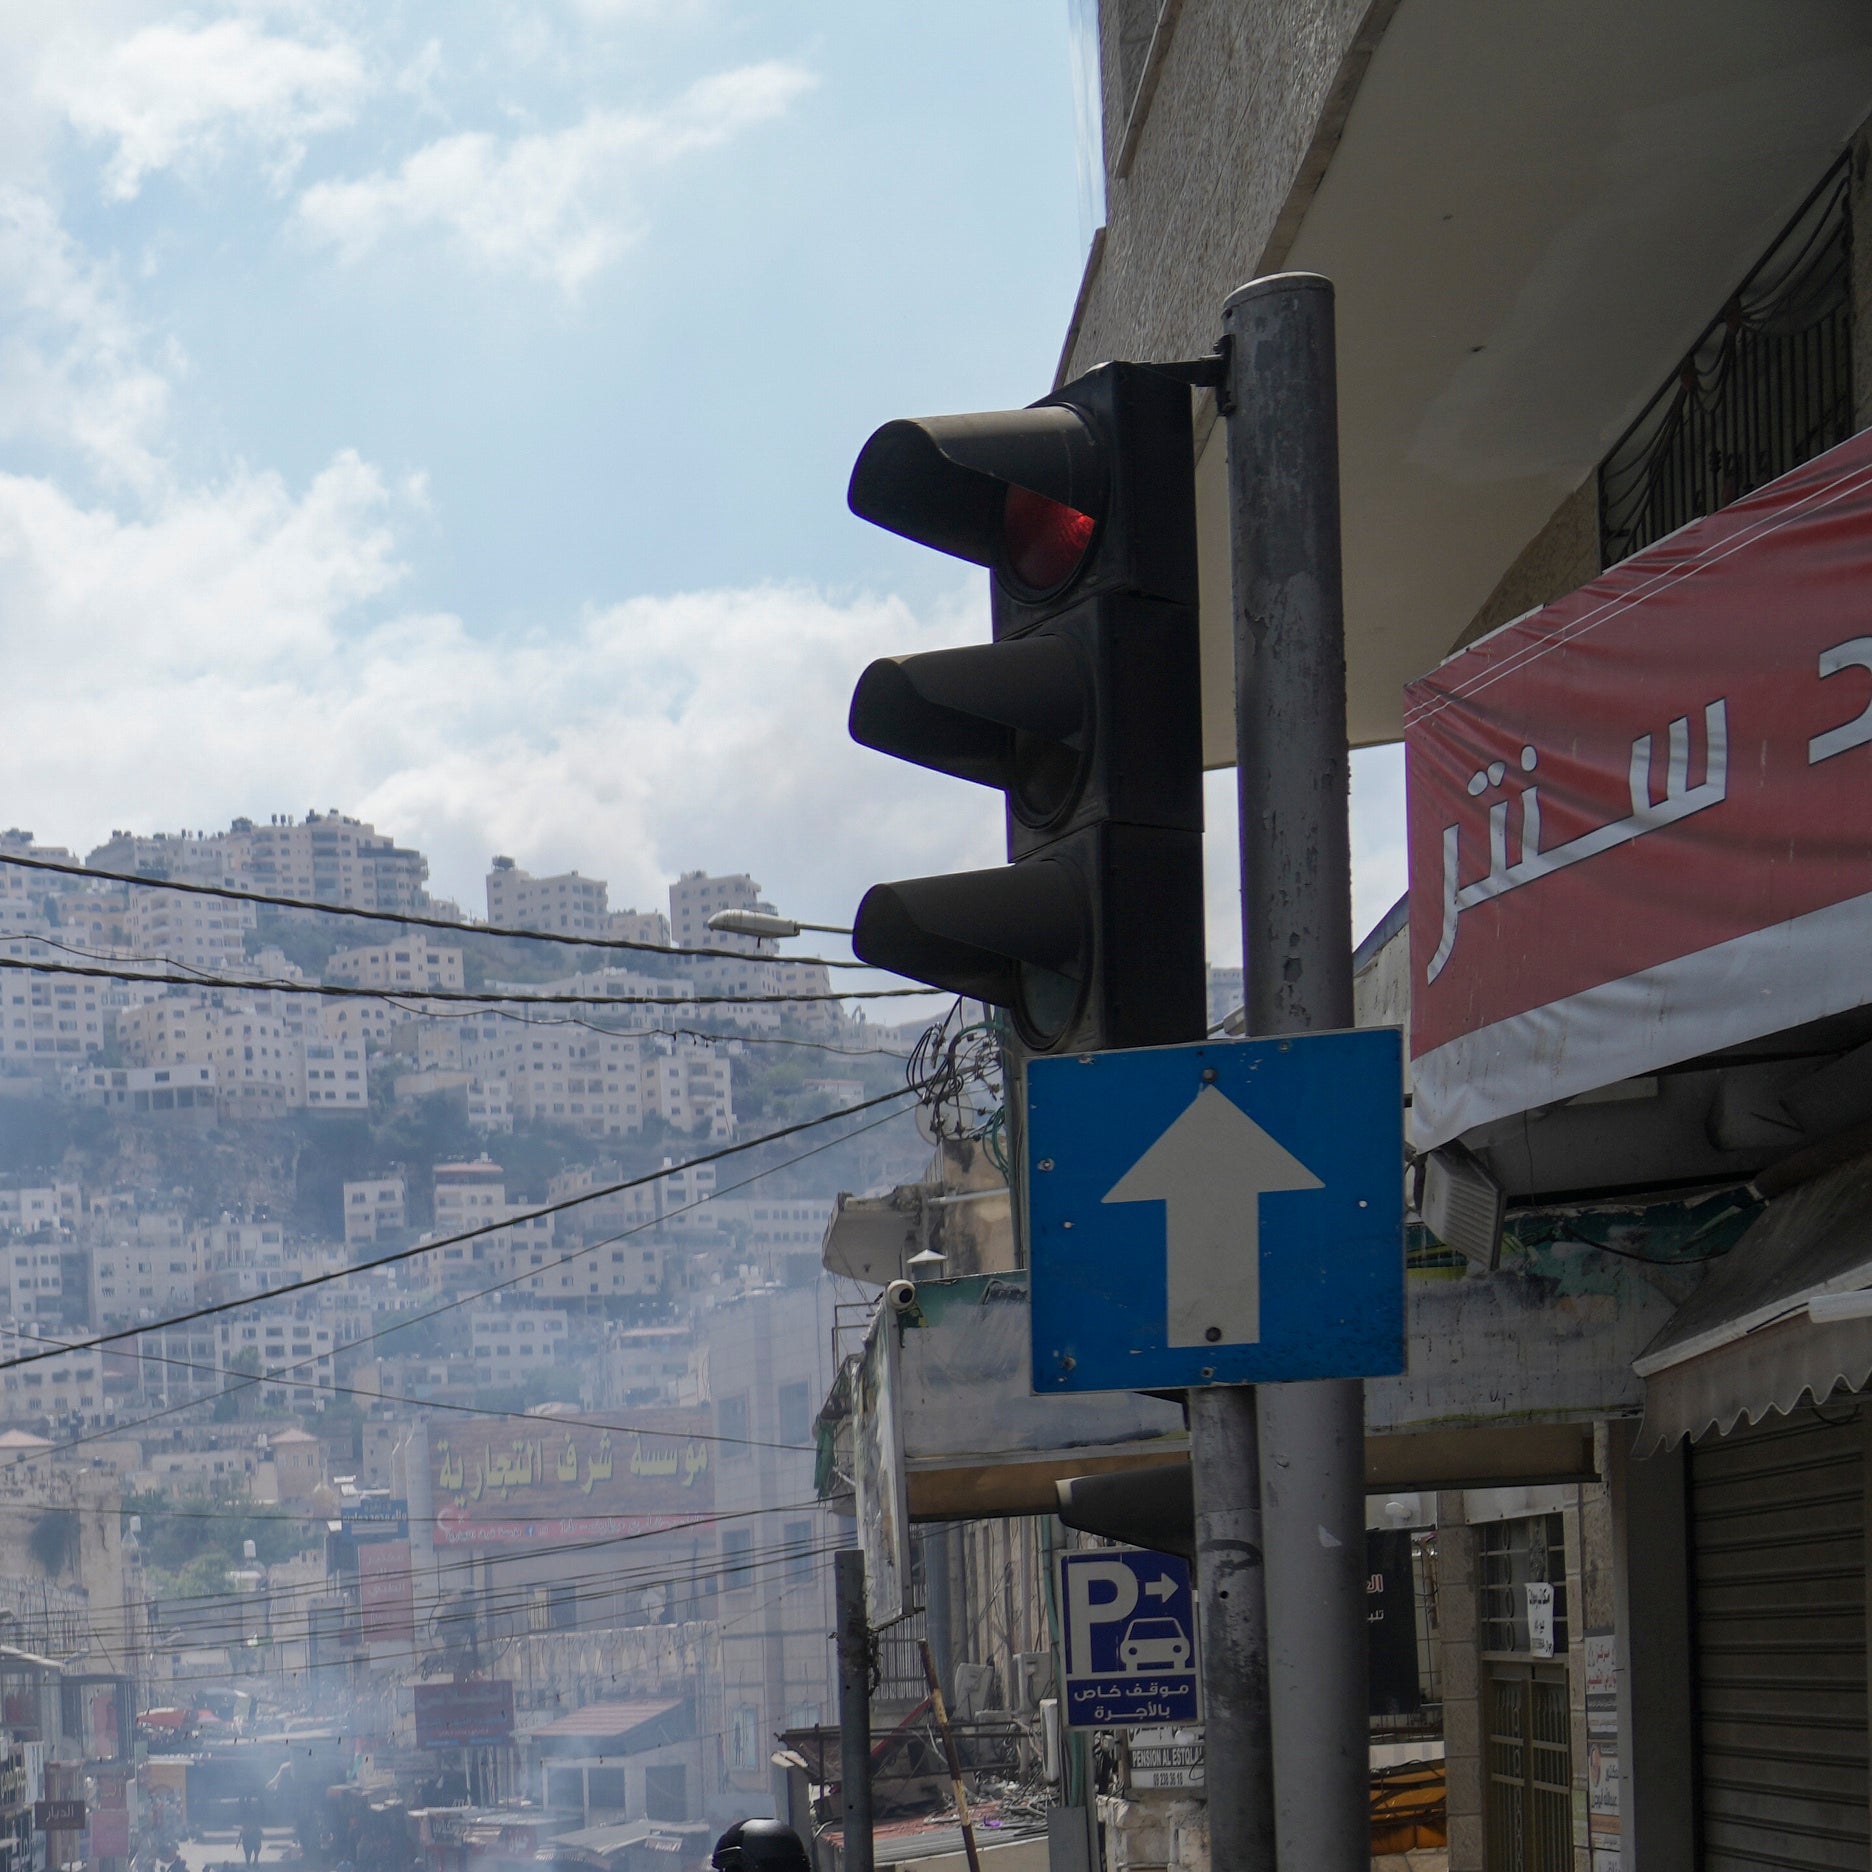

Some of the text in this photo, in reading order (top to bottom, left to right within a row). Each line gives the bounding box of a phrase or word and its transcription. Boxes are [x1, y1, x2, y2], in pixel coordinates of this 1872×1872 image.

[436, 1438, 544, 1508] التجارية
[556, 1427, 614, 1496] شرف
[1068, 1561, 1139, 1674] P
[1074, 1682, 1189, 1701] موقف خاص
[1094, 1701, 1171, 1722] بالأجرة
[1132, 1749, 1161, 1767] PENSION
